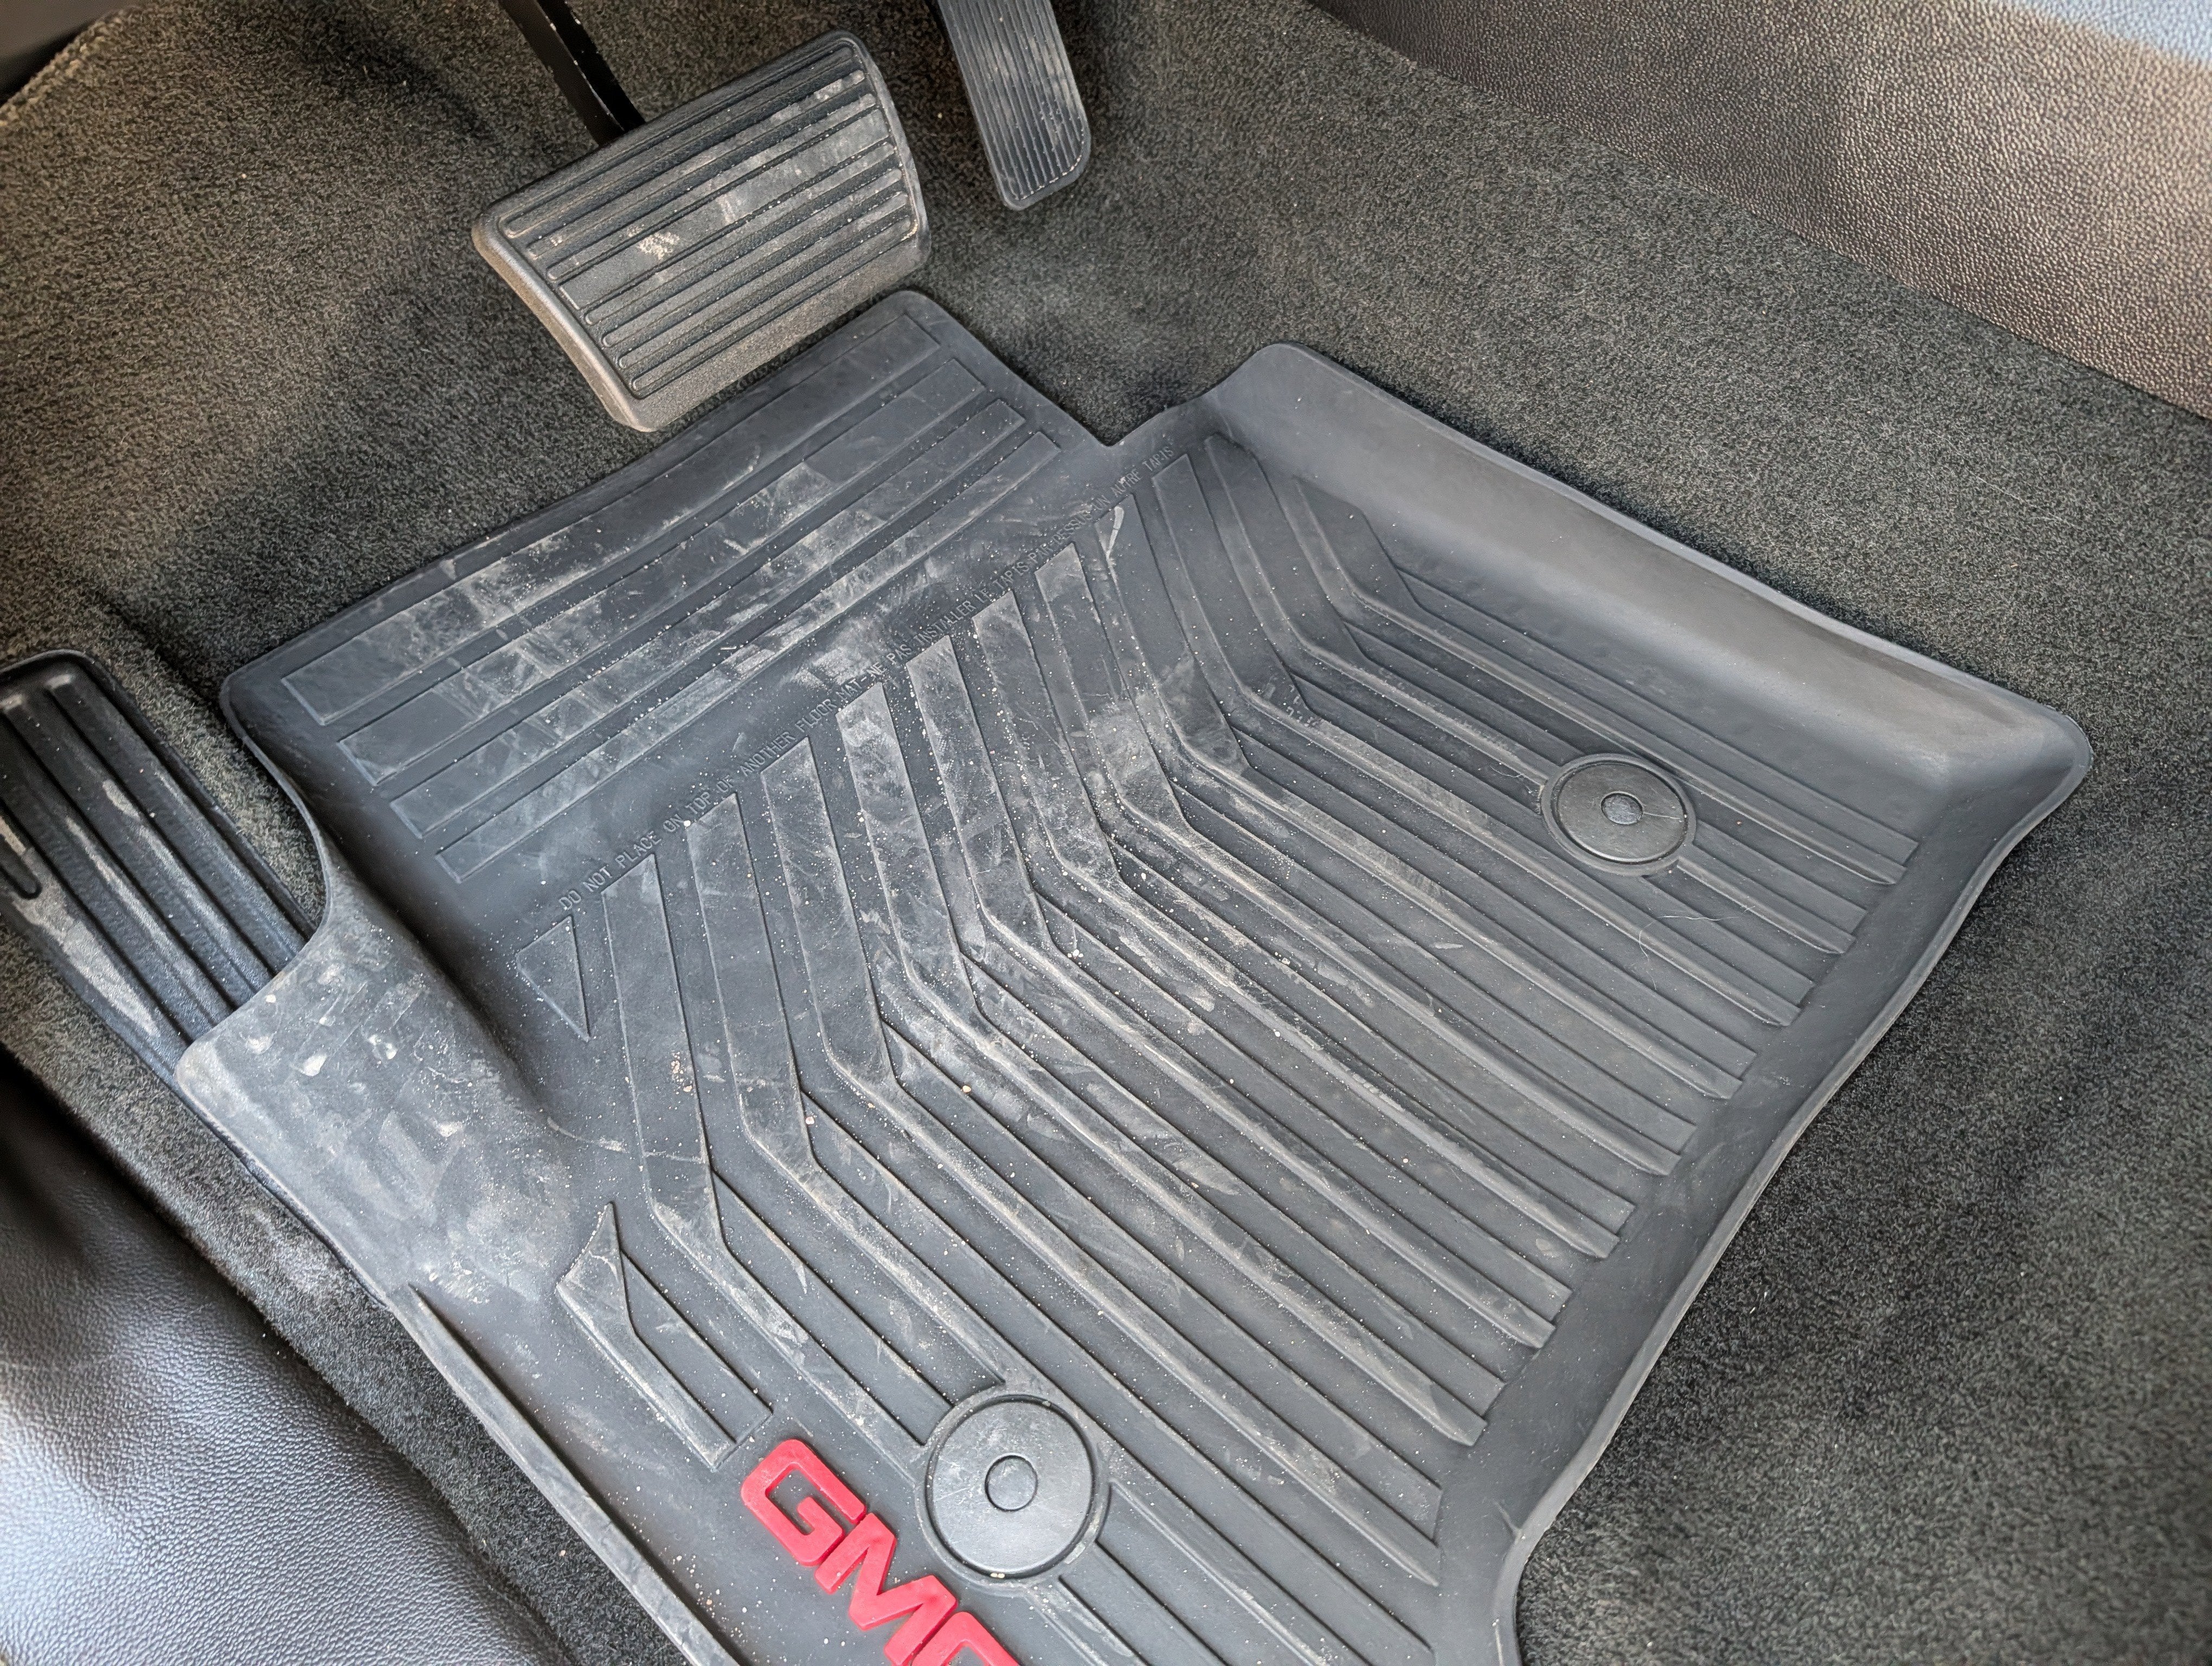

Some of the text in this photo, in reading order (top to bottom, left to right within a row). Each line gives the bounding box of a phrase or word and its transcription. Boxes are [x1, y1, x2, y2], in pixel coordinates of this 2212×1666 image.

[558, 888, 581, 911] DO
[583, 867, 613, 893] NOT
[615, 831, 663, 869] PLACE
[664, 813, 685, 833] ON
[685, 791, 714, 815] TOP
[716, 774, 735, 793] OF
[740, 731, 797, 776] ANOTHER
[795, 698, 838, 733] FLOOR
[886, 643, 912, 665] PAS
[913, 599, 977, 645] INSTALLER
[992, 561, 1031, 588] TAPIS
